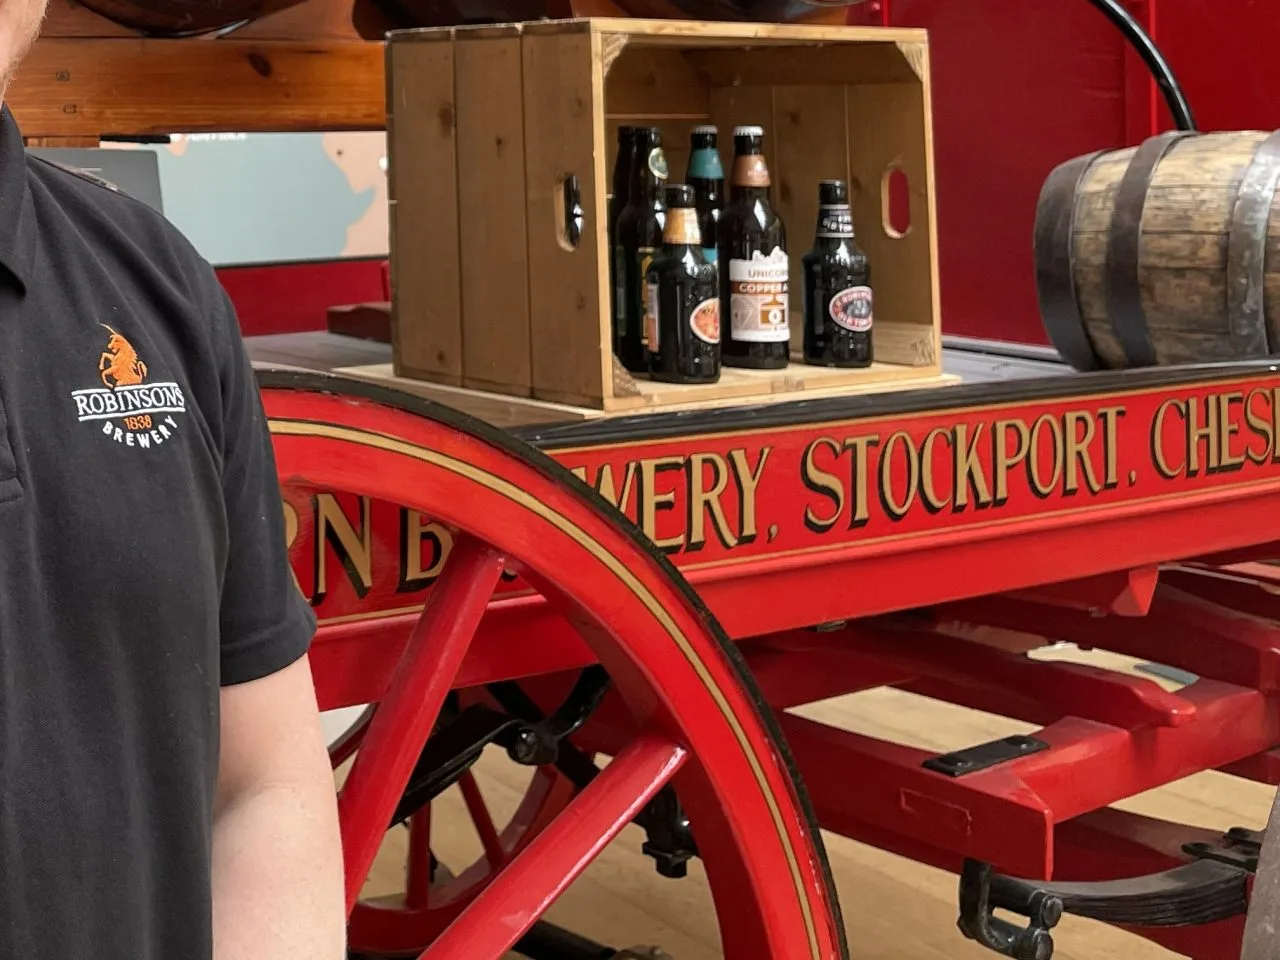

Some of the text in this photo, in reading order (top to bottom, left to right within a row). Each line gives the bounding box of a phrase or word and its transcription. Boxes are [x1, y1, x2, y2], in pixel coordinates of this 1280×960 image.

[73, 386, 185, 416] ROBINSONS
[102, 415, 178, 449] BREWERY
[124, 415, 153, 430] 1838
[1148, 386, 1280, 479] CHES
